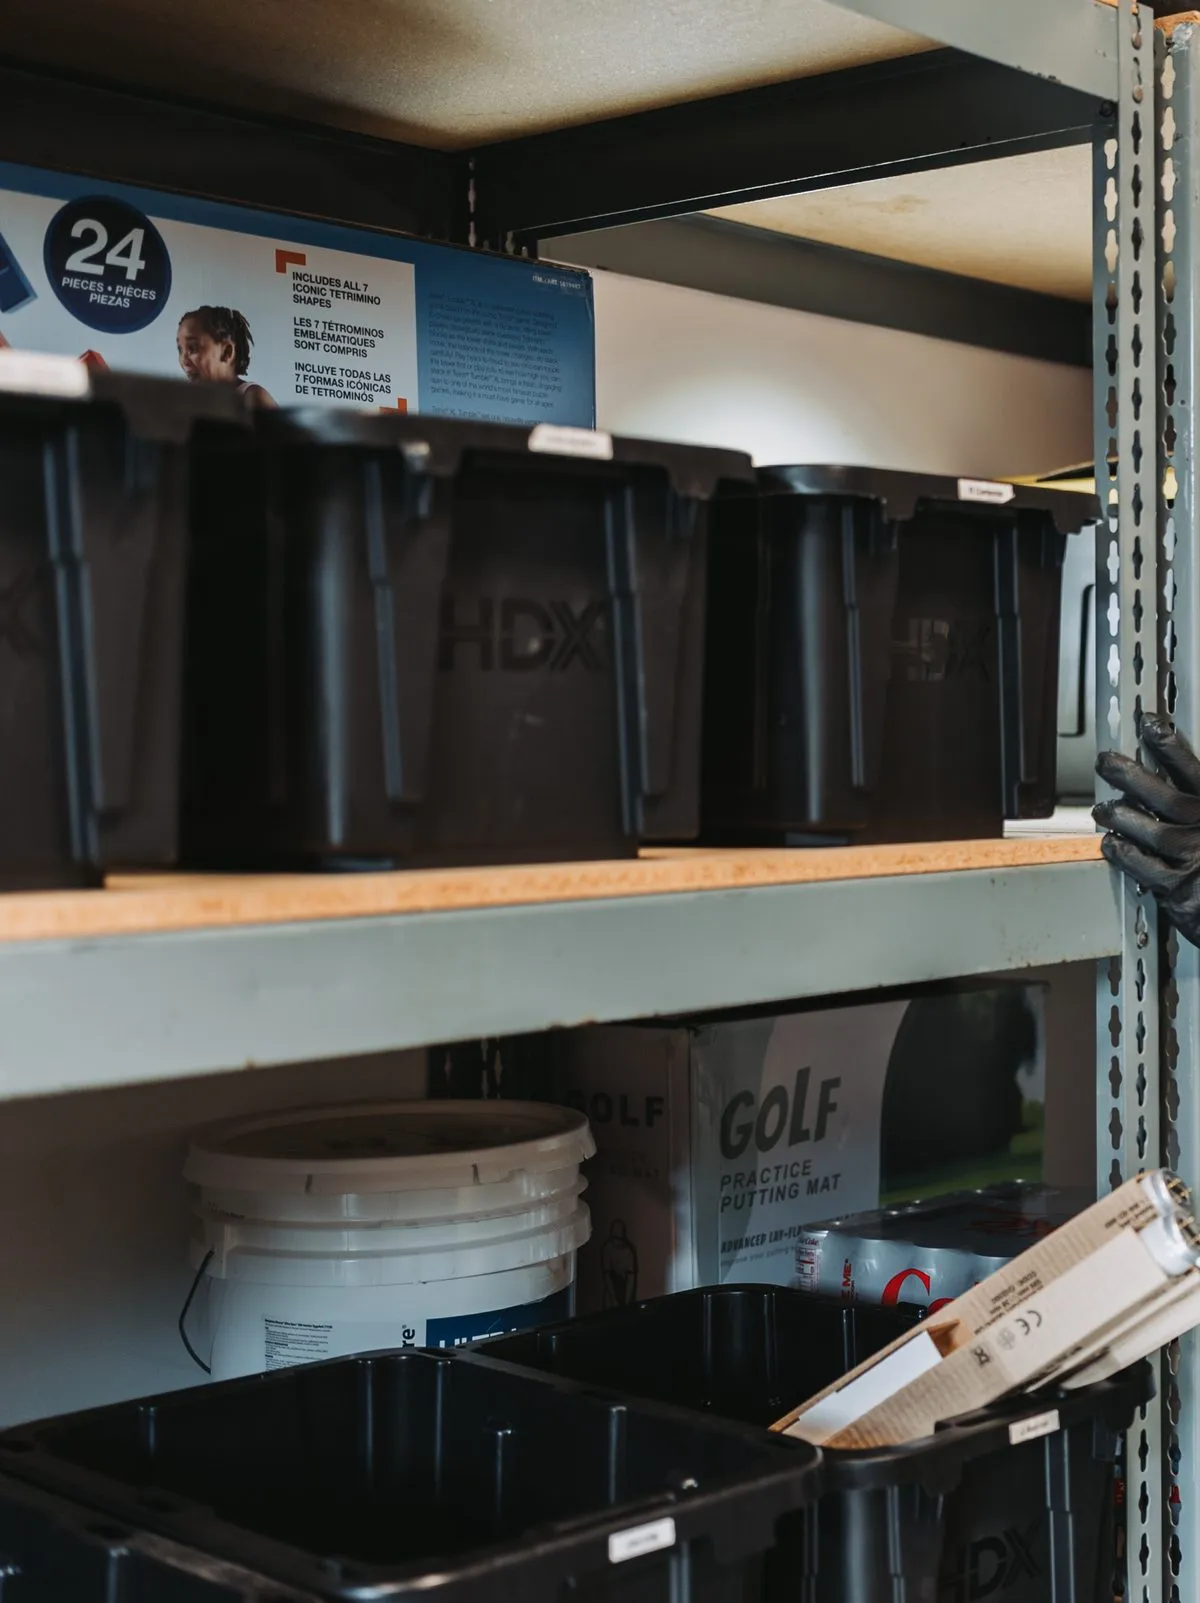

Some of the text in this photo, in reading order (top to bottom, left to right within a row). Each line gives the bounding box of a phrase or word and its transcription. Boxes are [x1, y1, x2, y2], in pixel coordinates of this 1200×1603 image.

[65, 218, 146, 280] 24
[61, 276, 156, 300] PIECES PIÈCES
[292, 271, 368, 292] INCLUDES ALL 7
[89, 293, 130, 308] PIEZAS
[293, 283, 381, 305] ICONIC TETRIMINO
[293, 294, 332, 308] SHAPES
[294, 317, 384, 339] LES 7 TÉTROMINOS
[294, 328, 375, 348] EMBLÉMATIQUES
[294, 340, 367, 358] SONT COMPRIS
[295, 362, 391, 383] INCLUYE TODAS LAS
[295, 385, 374, 403] DE TETROMINÓS
[296, 374, 391, 394] 7 FORMAS ICÓNICAS
[439, 597, 608, 672] HDX
[719, 1066, 841, 1160] GOLF
[720, 1159, 812, 1192] PRACTICE
[720, 1173, 841, 1214] PUTTING MAT
[721, 1234, 766, 1254] ADVANCED
